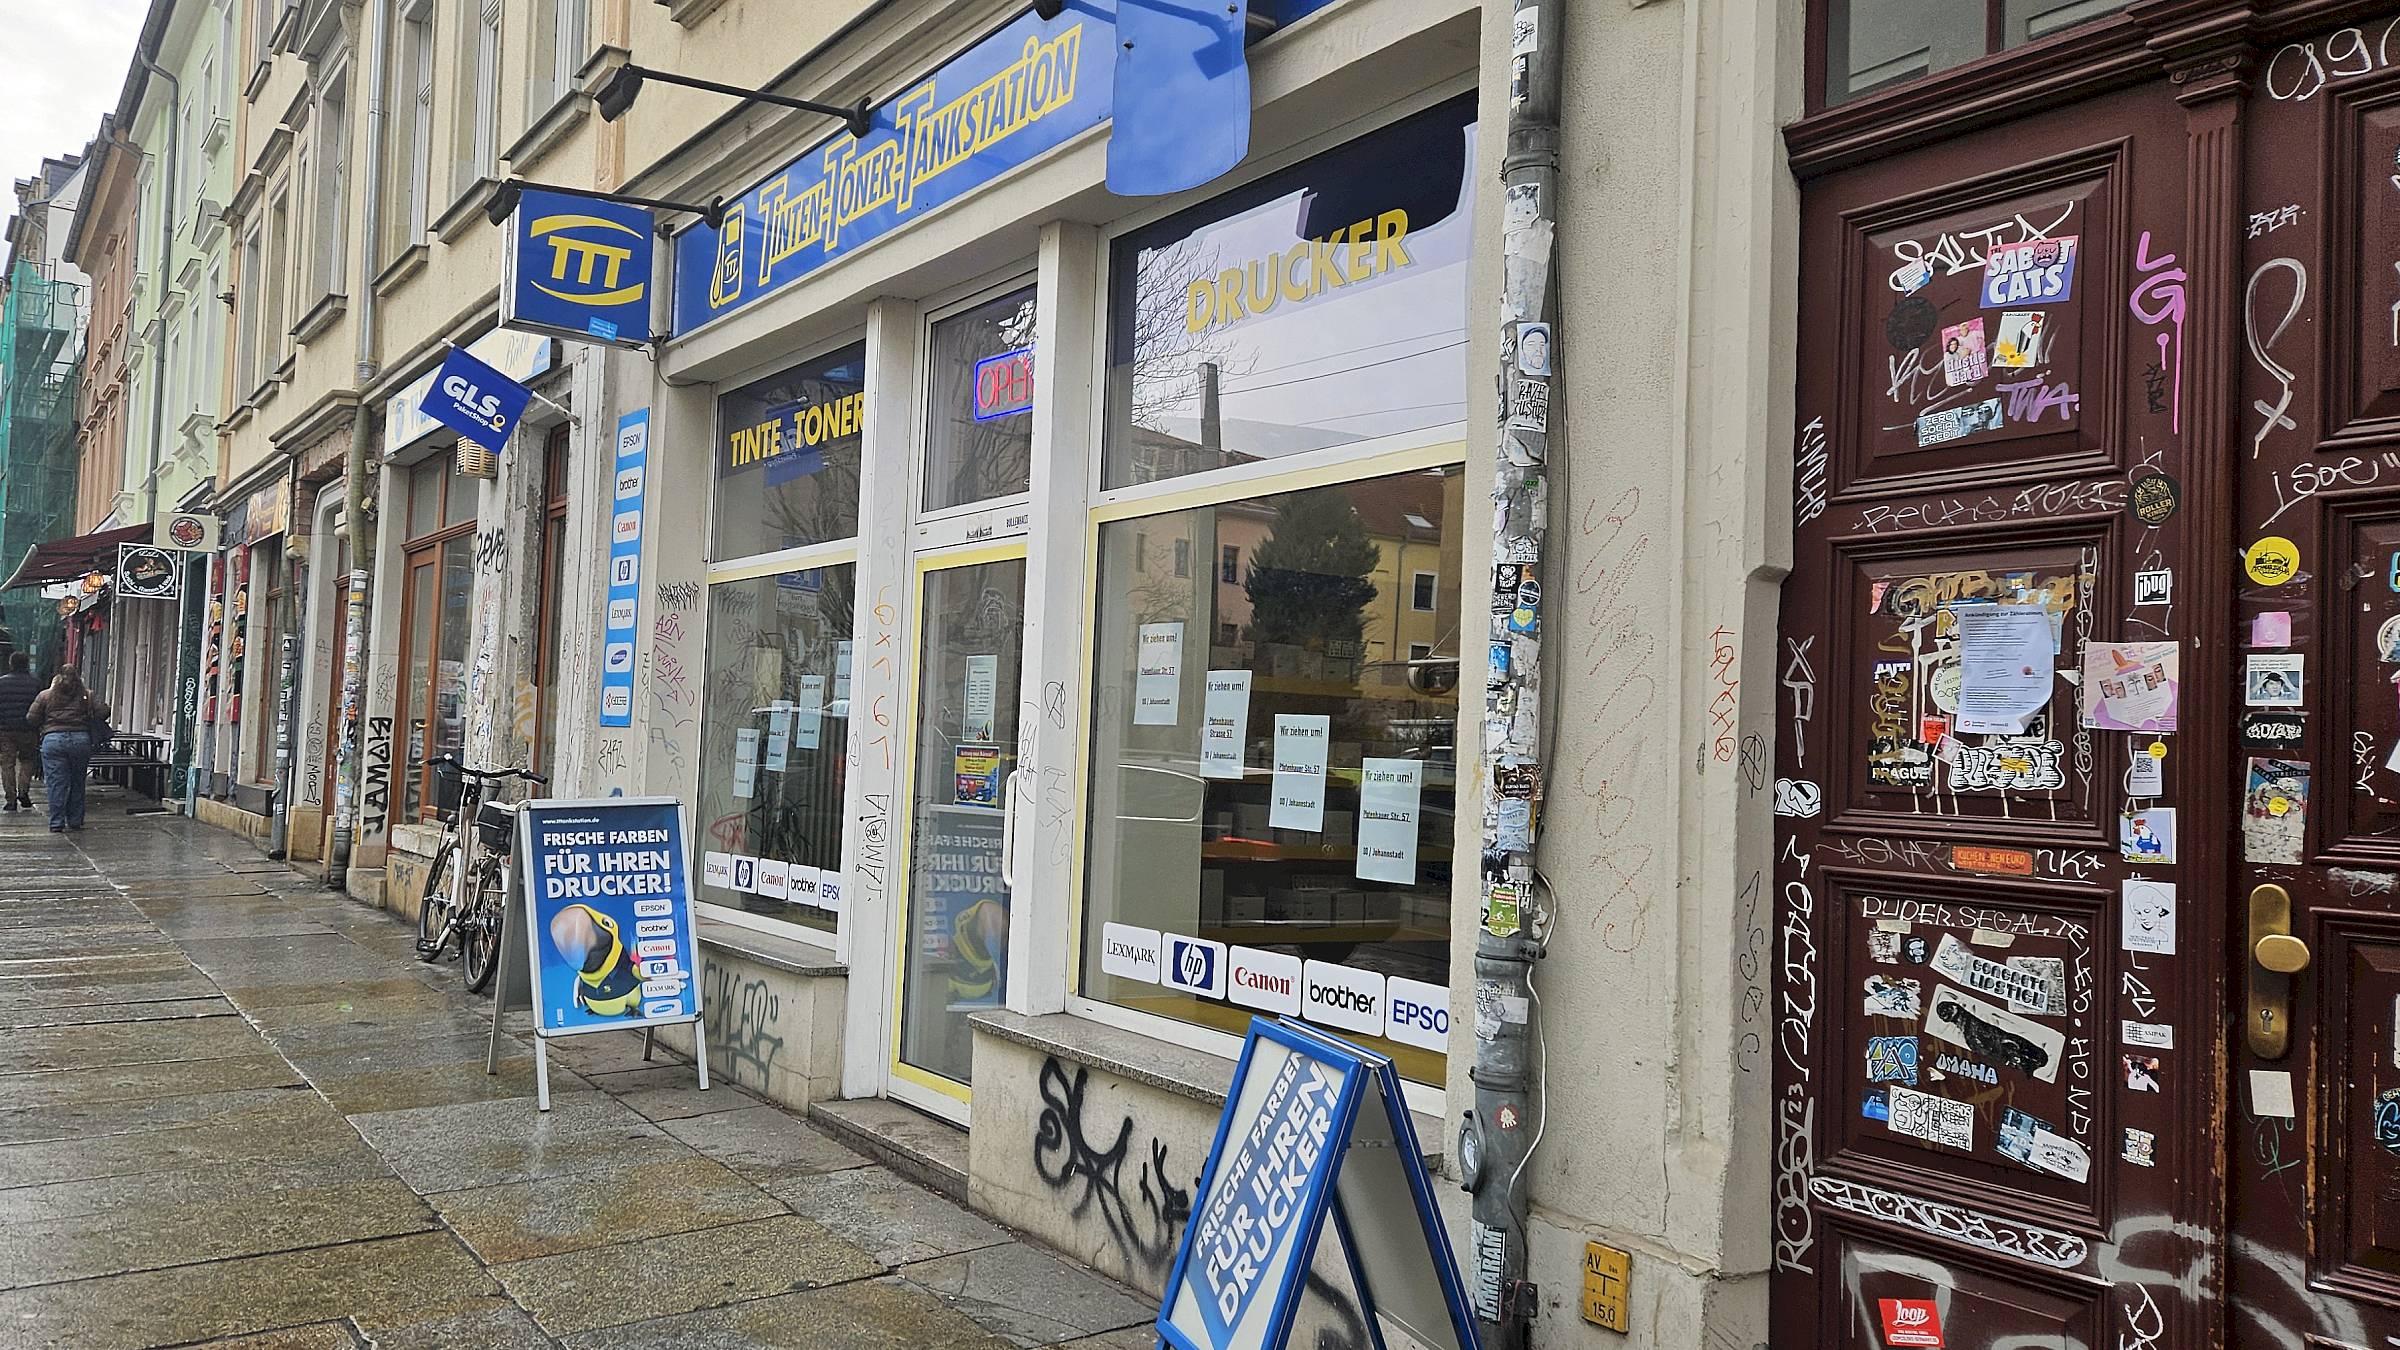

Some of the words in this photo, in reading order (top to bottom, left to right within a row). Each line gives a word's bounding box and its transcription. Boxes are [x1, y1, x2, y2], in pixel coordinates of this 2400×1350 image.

[1185, 208, 1411, 334] DRUCKER
[1989, 264, 2064, 304] CATS
[1951, 365, 1984, 384] Hard
[443, 375, 501, 418] GLS
[453, 402, 489, 427] PaketShop
[1925, 412, 1955, 426] ZERO
[729, 418, 781, 468] TINTE
[794, 391, 864, 449] TONER
[1921, 421, 1959, 436] SOCIAL
[1922, 429, 1960, 445] CREDIT
[622, 431, 642, 448] EPSON
[619, 469, 639, 492] brother
[2139, 499, 2172, 517] ROLLER
[617, 514, 636, 534] Canon
[2138, 574, 2168, 600] ibug
[1214, 681, 1231, 691] ziehen
[1231, 682, 1244, 692] um!
[1280, 725, 1289, 736] Wir
[1290, 726, 1309, 737] ziehen
[1311, 726, 1323, 737] um!
[1313, 765, 1320, 774] 57
[1365, 770, 1373, 781] Wir
[1374, 770, 1395, 782] ziehen
[1397, 771, 1413, 783] um!
[1872, 767, 1928, 780] PRAGUE
[1288, 797, 1315, 809] Johannstadt
[543, 831, 605, 846] FRISCHE
[610, 829, 668, 844] FARBEN
[544, 848, 592, 875] FÜR
[599, 850, 671, 873] IHREN
[1372, 848, 1404, 859] Johannstadt
[706, 862, 728, 876] LEXMARK
[546, 872, 673, 899] DRUCKER!
[761, 873, 784, 887] Canon
[791, 878, 816, 894] brother
[640, 904, 666, 912] EPSON
[640, 923, 668, 932] brother
[1106, 938, 1155, 966] LEXMARK
[1234, 966, 1290, 996] Canon
[1310, 979, 1376, 1014] brother
[1969, 972, 2045, 1010] LIPSTICK
[1935, 1053, 1999, 1085] OMAHA
[1195, 1144, 1253, 1260] FRISCHE
[1251, 1051, 1303, 1148] FARBEN
[1205, 1203, 1257, 1295] FÜR
[1251, 1061, 1328, 1202] IHREN
[1217, 1085, 1339, 1328] DRUCKER!
[1587, 1253, 1602, 1268] AV
